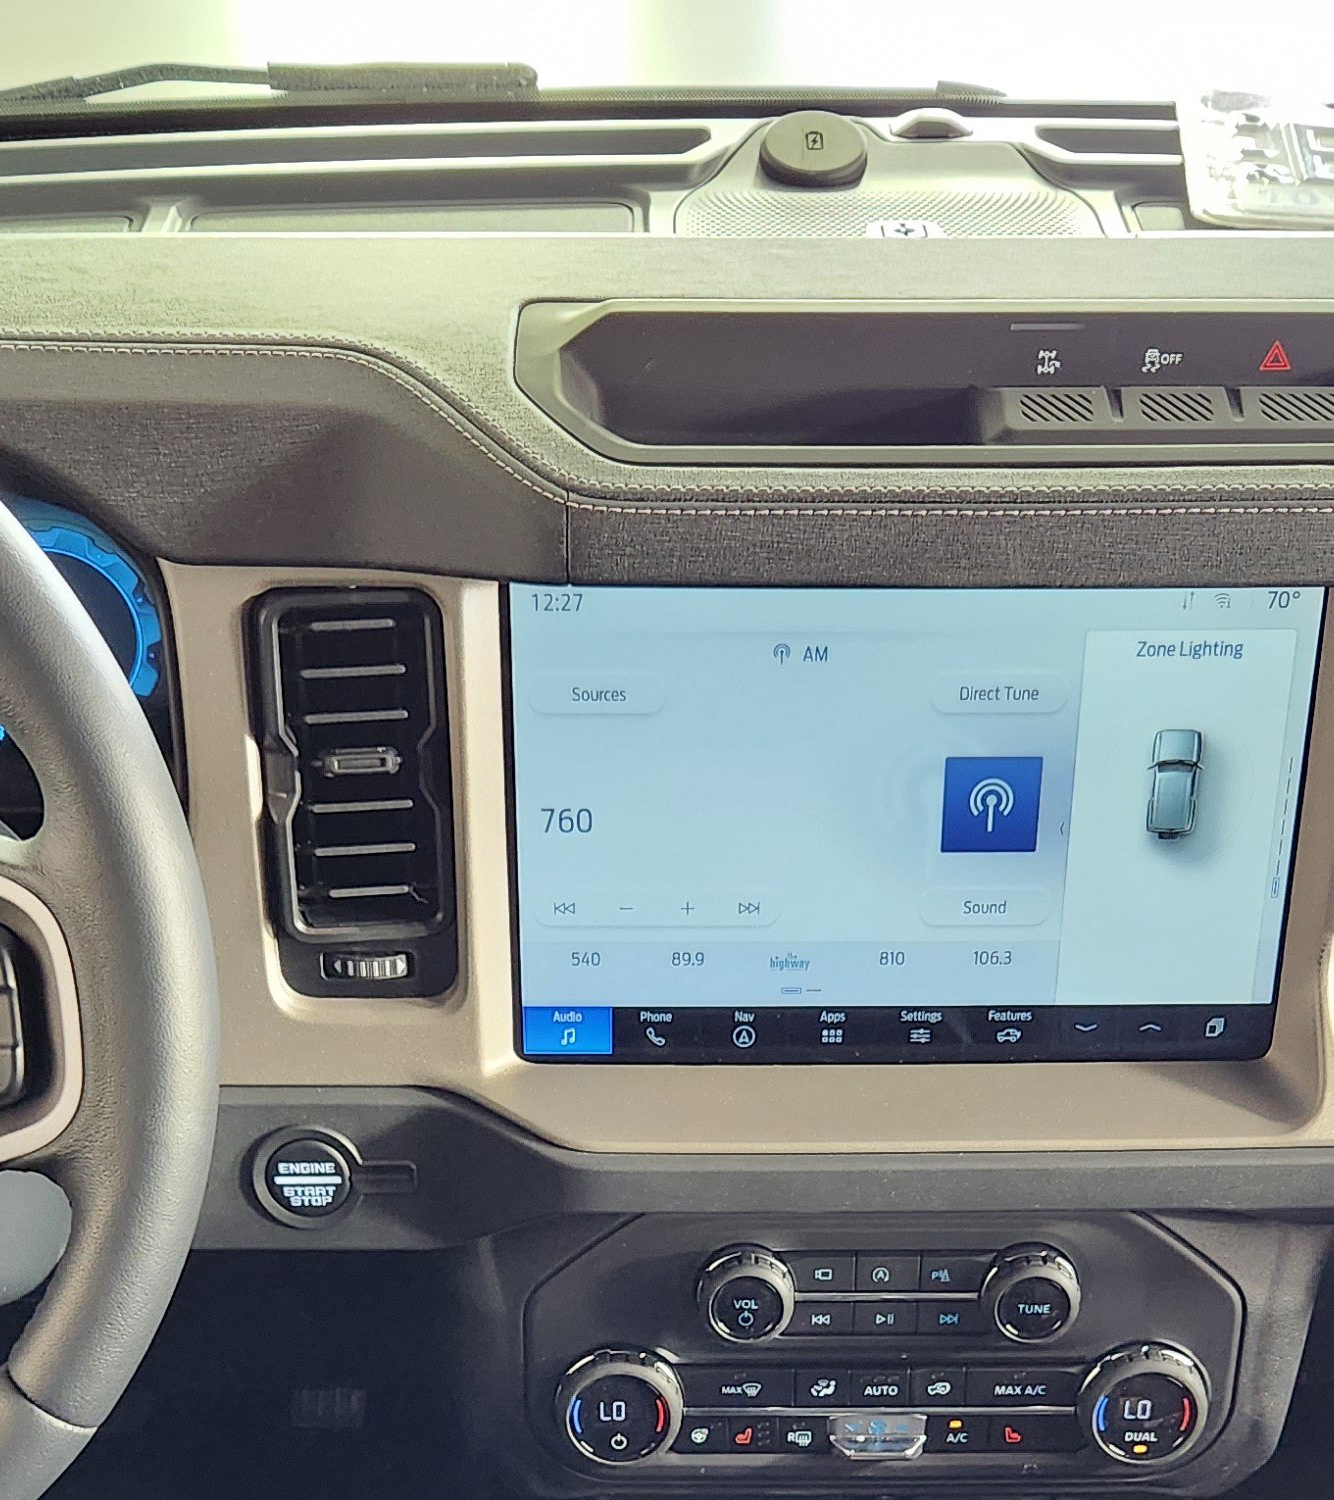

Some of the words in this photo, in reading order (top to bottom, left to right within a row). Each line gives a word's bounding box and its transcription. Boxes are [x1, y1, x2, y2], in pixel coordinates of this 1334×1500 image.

[1160, 352, 1184, 367] OFF
[531, 593, 583, 612] 12:27
[1267, 591, 1301, 610] 70°
[803, 646, 829, 663] AM
[1136, 641, 1176, 658] Zone
[1180, 640, 1244, 660] Lighting
[571, 687, 627, 702] Sources
[959, 686, 1000, 701] Direct
[1004, 686, 1040, 701] Tune
[541, 808, 593, 833] 760
[962, 899, 1007, 916] Sound
[571, 952, 601, 967] 540
[671, 952, 705, 967] 89.9
[769, 956, 810, 971] highway
[879, 951, 905, 966] 810
[973, 951, 1012, 966] 106.3
[552, 1011, 582, 1023] Audio
[640, 1011, 673, 1023] Phone
[734, 1011, 755, 1023] Nav
[819, 1011, 846, 1024] Apps
[900, 1010, 942, 1024] Settings
[988, 1010, 1032, 1022] Features
[277, 1162, 336, 1175] ENGINE
[282, 1186, 336, 1197] START
[290, 1196, 333, 1207] STOP
[733, 1300, 759, 1310] VOL
[1018, 1304, 1051, 1315] TUNE
[721, 1385, 743, 1395] MAX
[864, 1385, 898, 1396] AUTO
[994, 1385, 1022, 1396] MAX
[1024, 1385, 1047, 1396] A/C
[599, 1401, 626, 1421] LO
[1124, 1400, 1151, 1420] LO
[946, 1433, 968, 1443] A/C
[1124, 1431, 1158, 1442] DUAL
